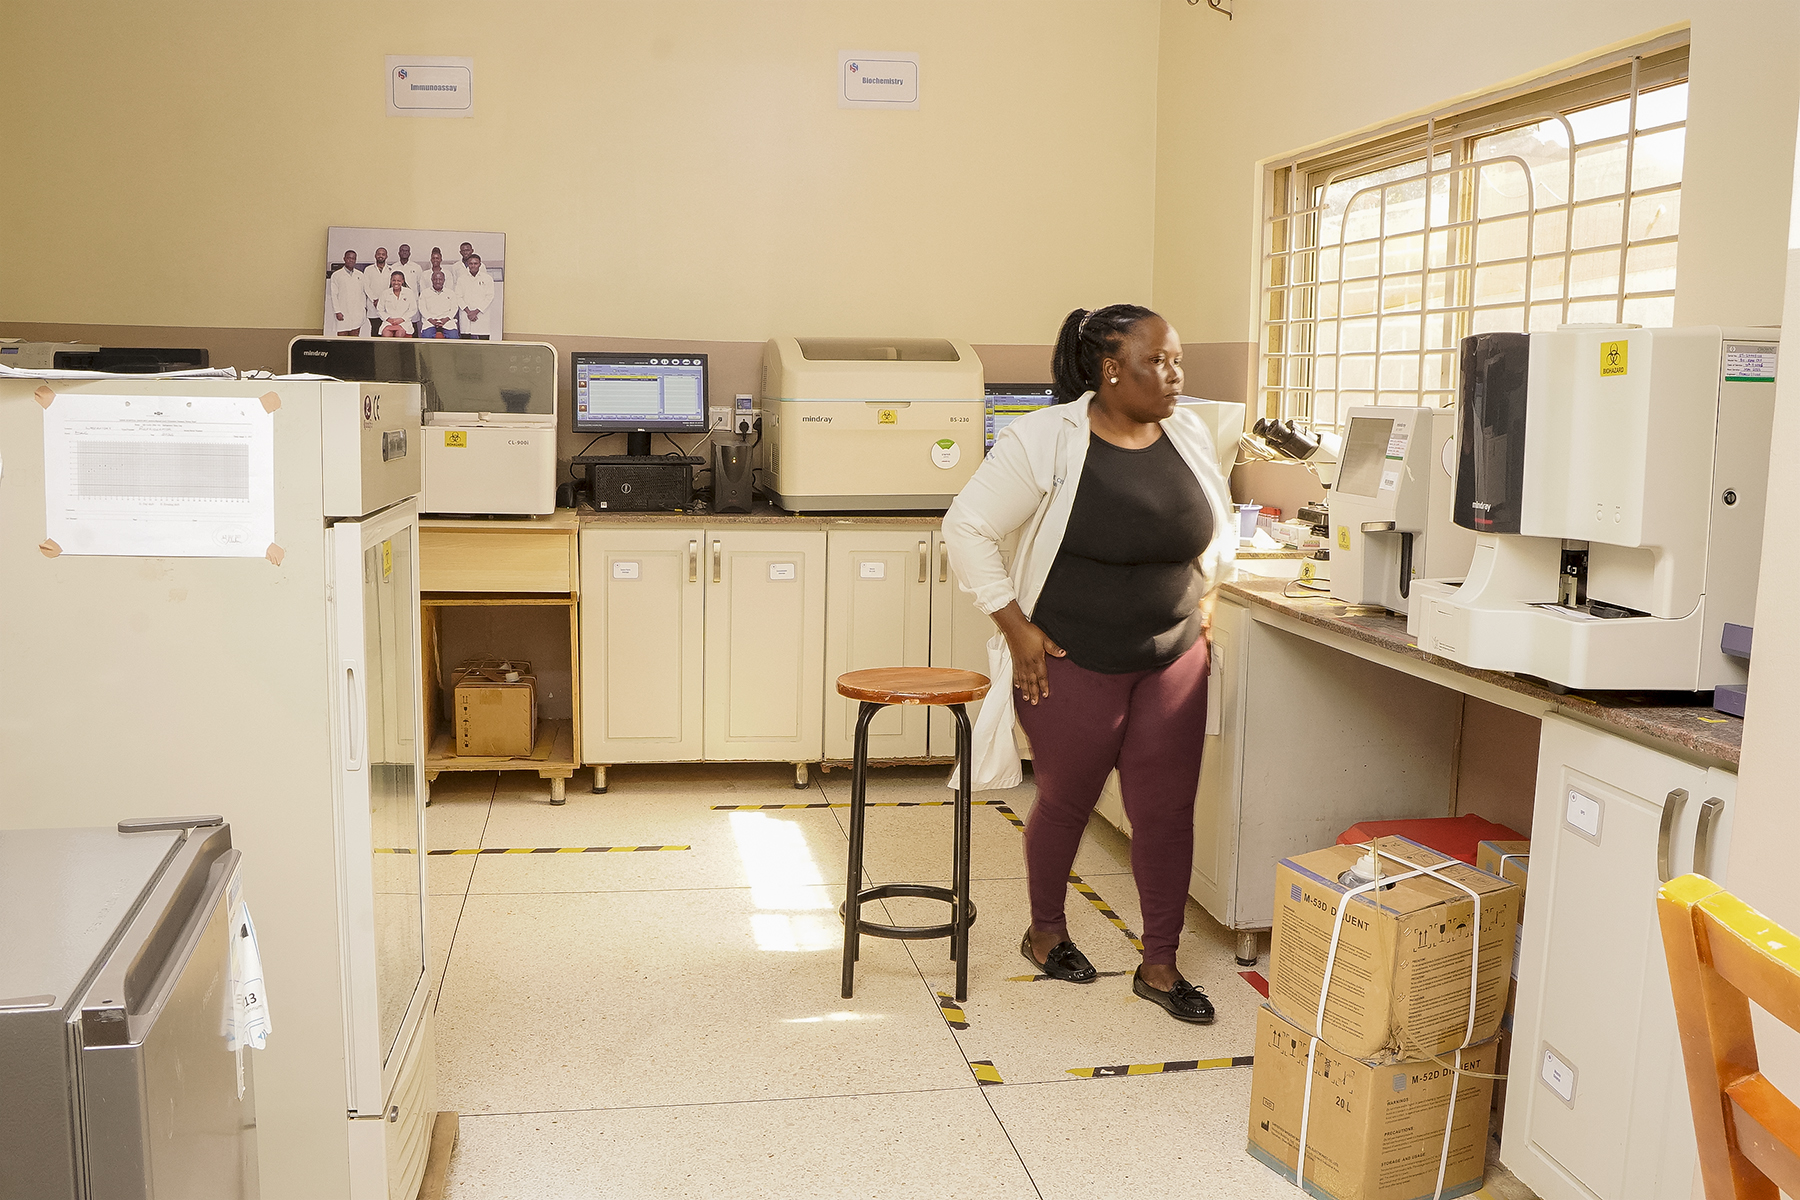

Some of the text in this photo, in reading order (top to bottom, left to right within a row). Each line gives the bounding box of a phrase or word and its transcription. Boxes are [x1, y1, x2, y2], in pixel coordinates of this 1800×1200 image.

[862, 77, 904, 86] Biochemistry
[410, 83, 458, 92] Immunoassay
[303, 349, 329, 358] mindray
[1602, 366, 1624, 375] BIOHAZARD
[802, 415, 833, 424] mindray
[1471, 500, 1492, 513] mindray
[1303, 893, 1370, 931] M-53D DUENT
[1411, 1070, 1440, 1084] M-52D
[1335, 1095, 1352, 1113] 20 L
